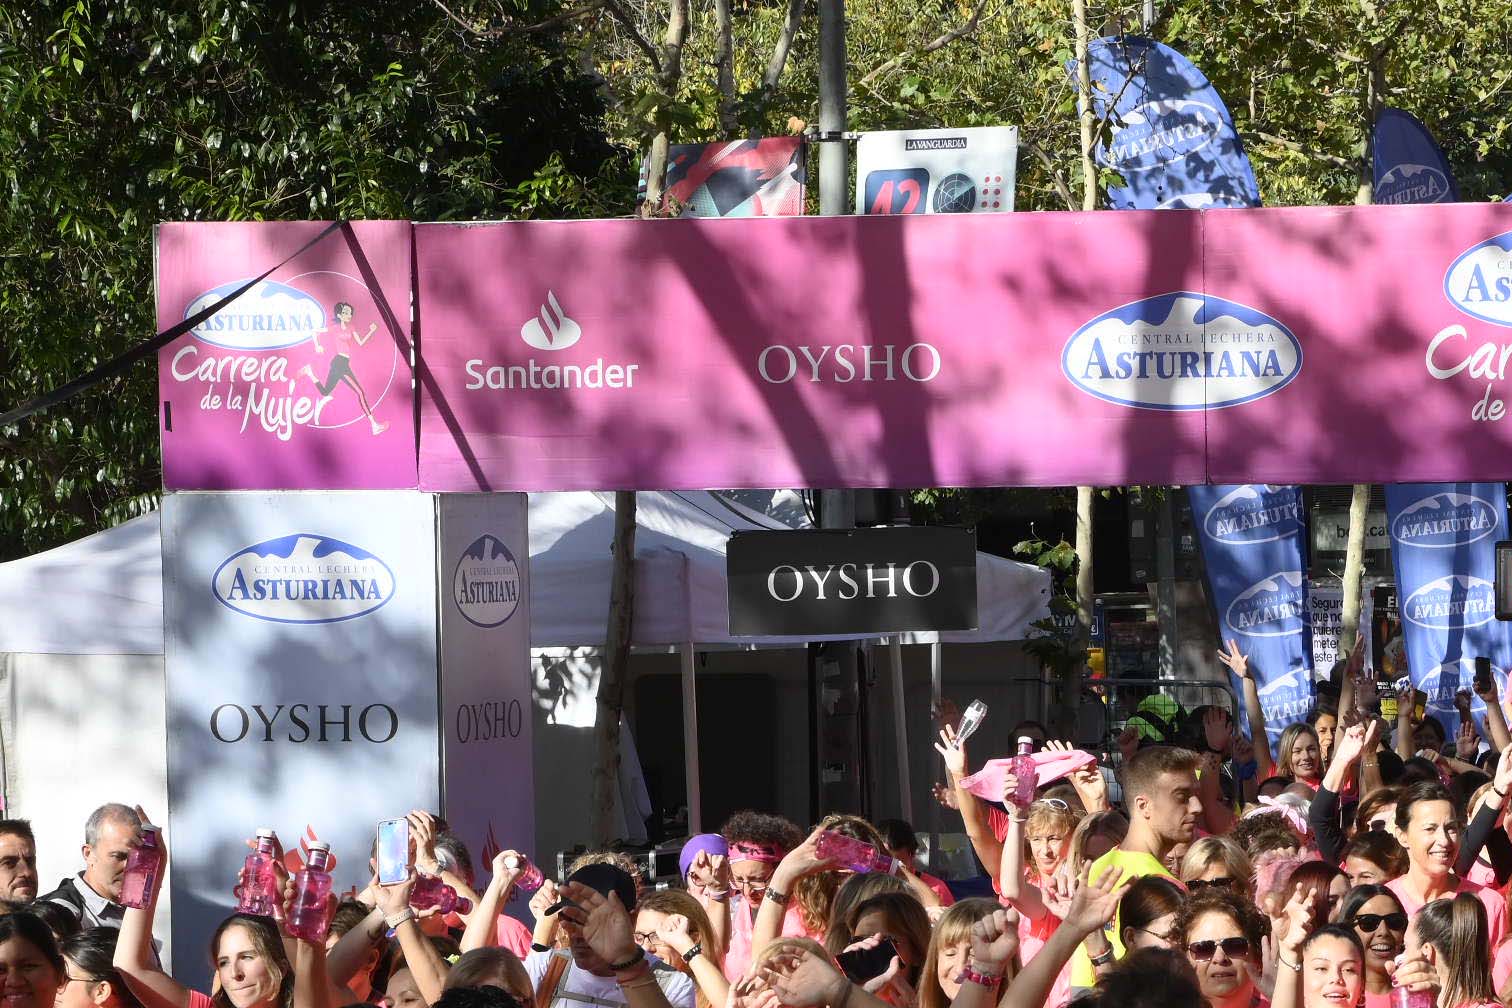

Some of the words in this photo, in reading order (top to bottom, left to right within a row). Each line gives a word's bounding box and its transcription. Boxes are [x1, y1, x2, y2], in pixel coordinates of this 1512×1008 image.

[1117, 333, 1193, 345] CENTRAL
[171, 345, 289, 383] Carrera
[466, 360, 639, 390] Santander
[758, 343, 941, 383] OYSHO
[1081, 337, 1284, 380] ASTURIANA
[200, 382, 221, 411] de
[226, 381, 242, 411] la
[240, 379, 333, 441] Mujer
[1471, 384, 1505, 421] de
[227, 567, 382, 601] ASTURIANA
[254, 565, 311, 574] CENTRAL
[459, 567, 516, 605] ASTURIANA
[767, 560, 939, 602] OYSHO
[1312, 612, 1328, 624] que
[1314, 651, 1333, 662] este
[210, 703, 399, 743] OYSHO
[456, 699, 522, 743] OYSHO
